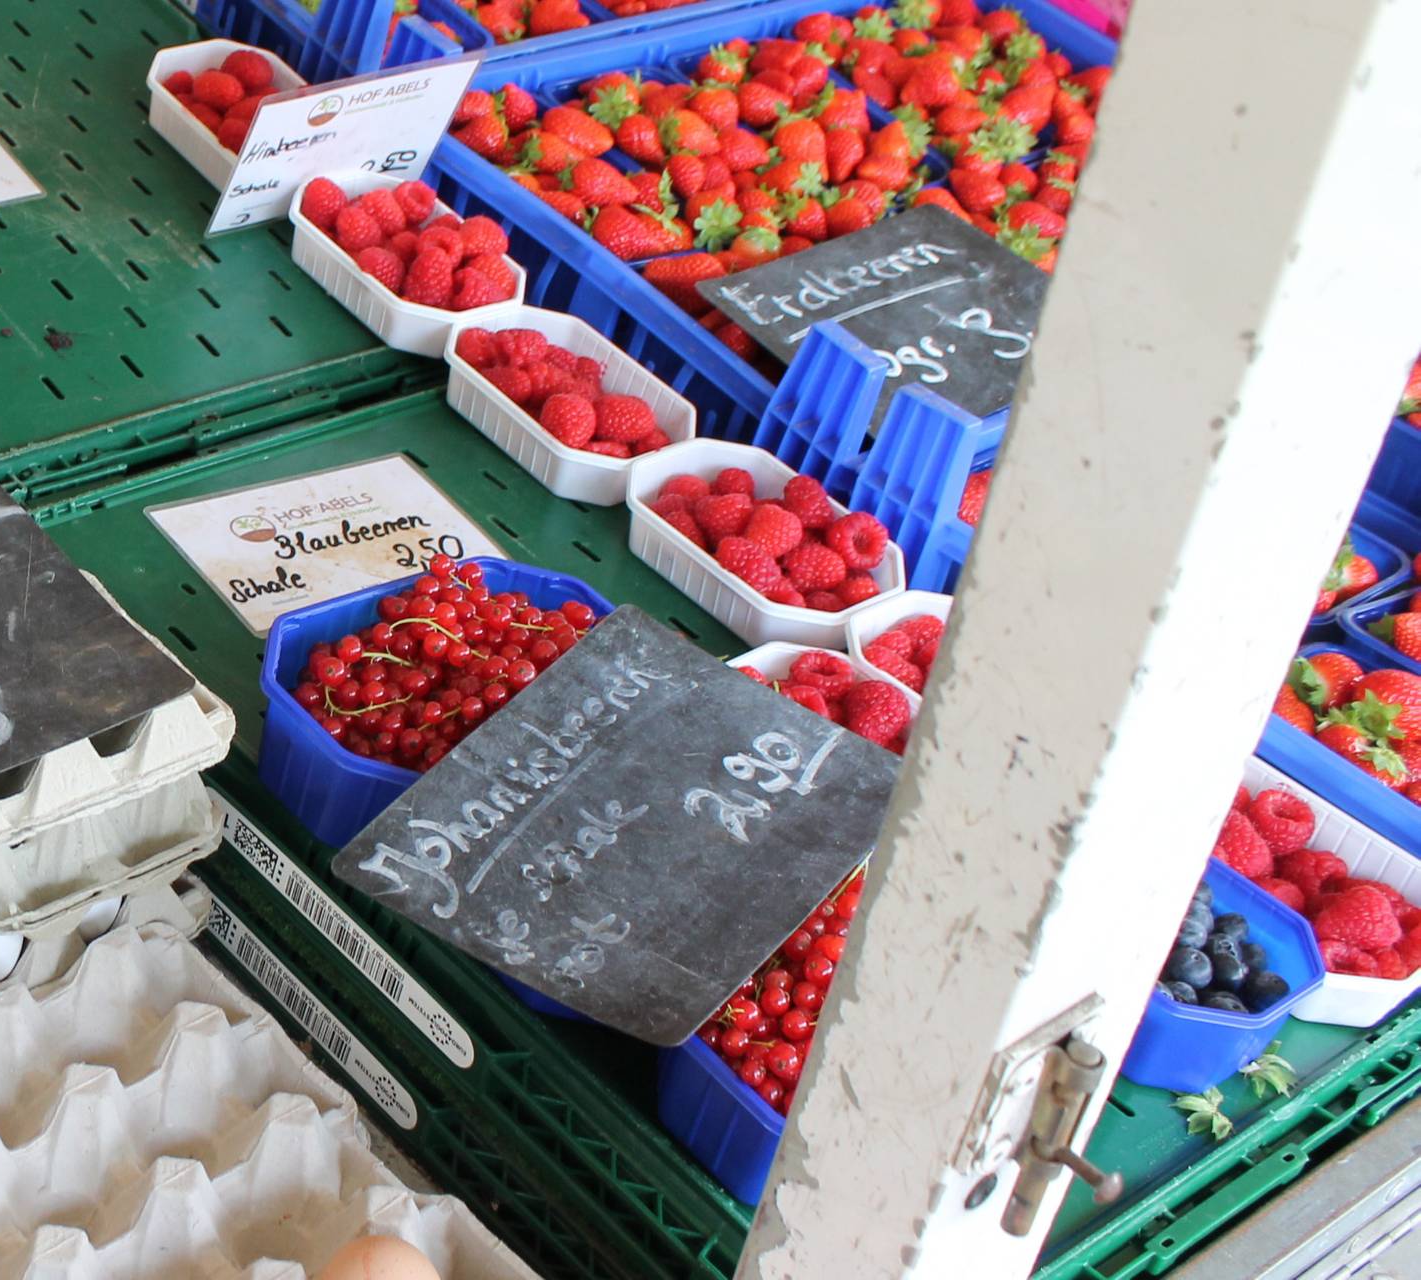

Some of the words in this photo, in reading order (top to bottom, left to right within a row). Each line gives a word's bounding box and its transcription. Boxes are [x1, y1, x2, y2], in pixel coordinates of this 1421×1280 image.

[347, 88, 384, 106] HOF
[384, 78, 432, 97] ABELS
[719, 243, 959, 326] Erdbeeren
[273, 504, 314, 522] HOF
[318, 493, 373, 513] ABELS
[228, 566, 307, 602] Schale
